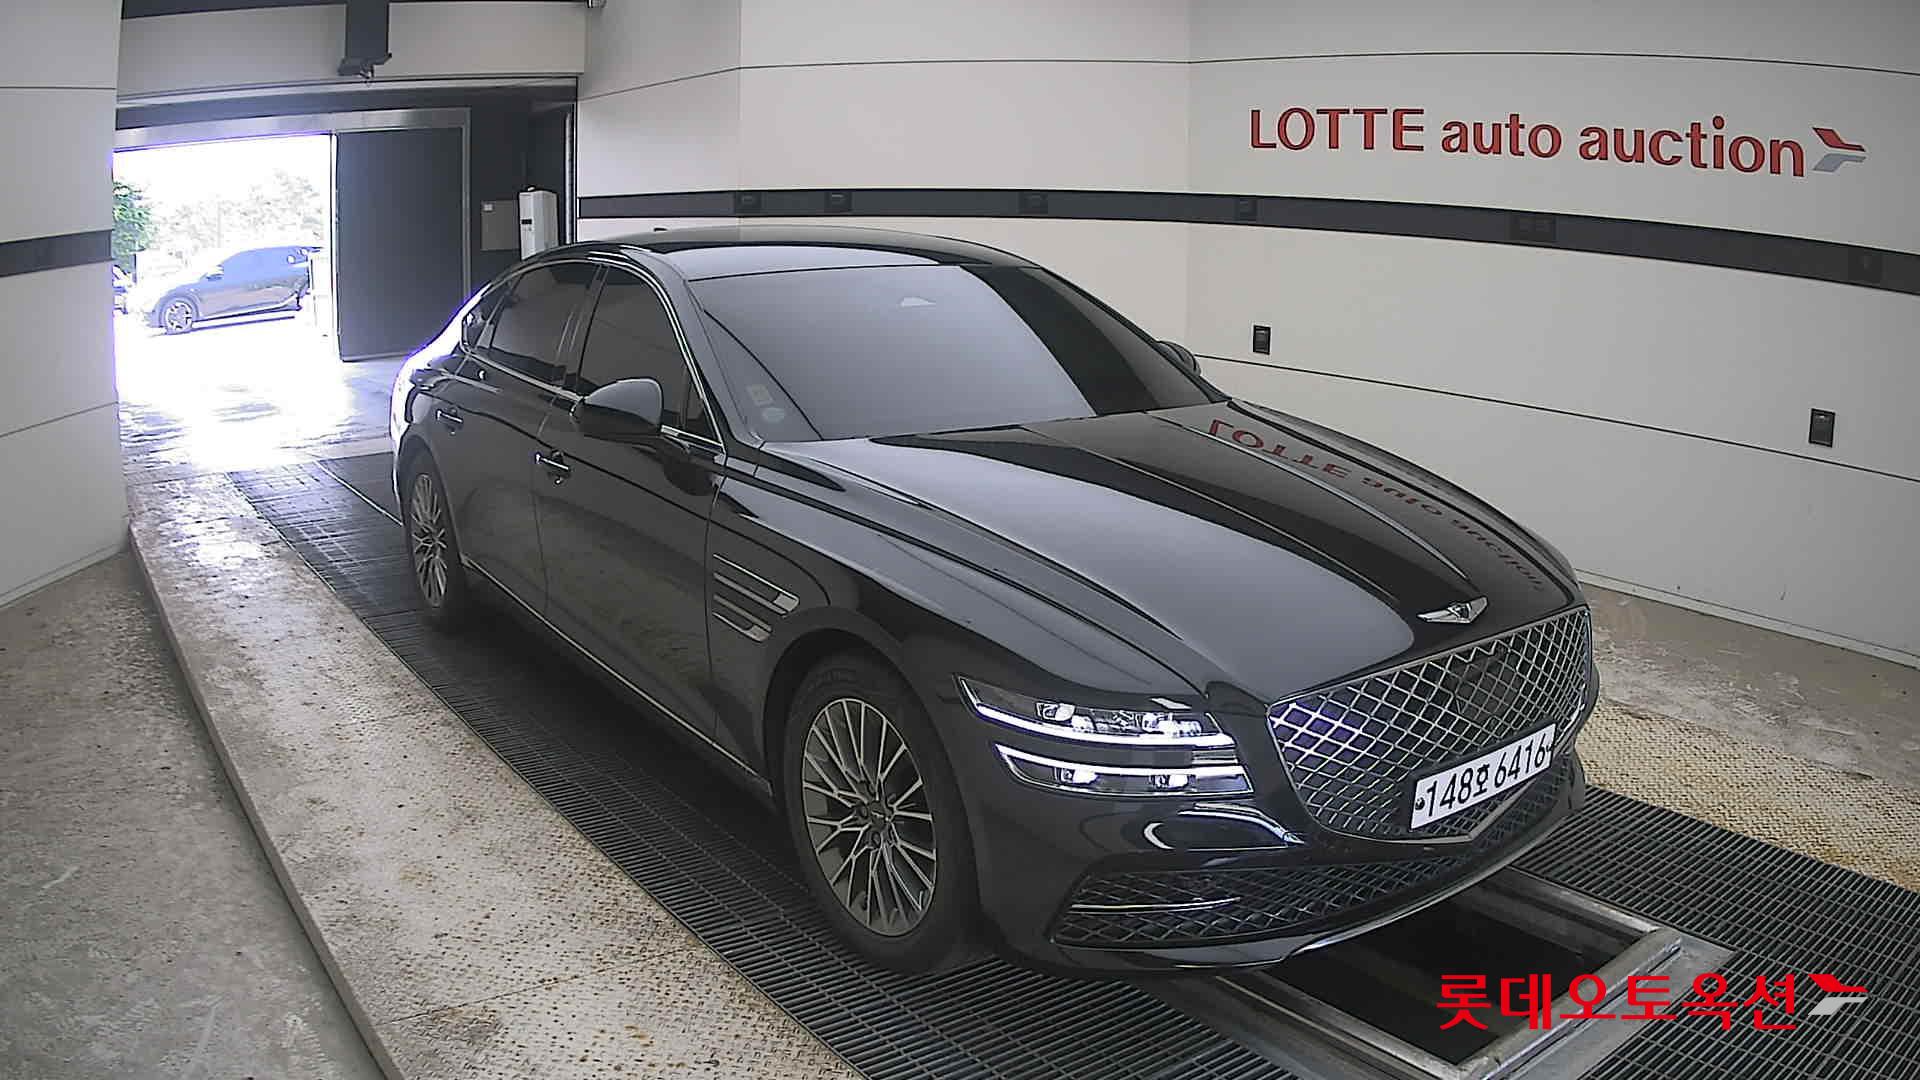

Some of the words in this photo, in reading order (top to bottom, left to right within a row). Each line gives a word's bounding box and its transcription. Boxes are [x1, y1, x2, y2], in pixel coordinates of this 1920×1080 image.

[1250, 107, 1425, 152] LOTTE
[1441, 113, 1563, 158] auto
[1578, 116, 1805, 177] auction
[1426, 763, 1490, 817] 148호
[1494, 732, 1547, 788] 6416
